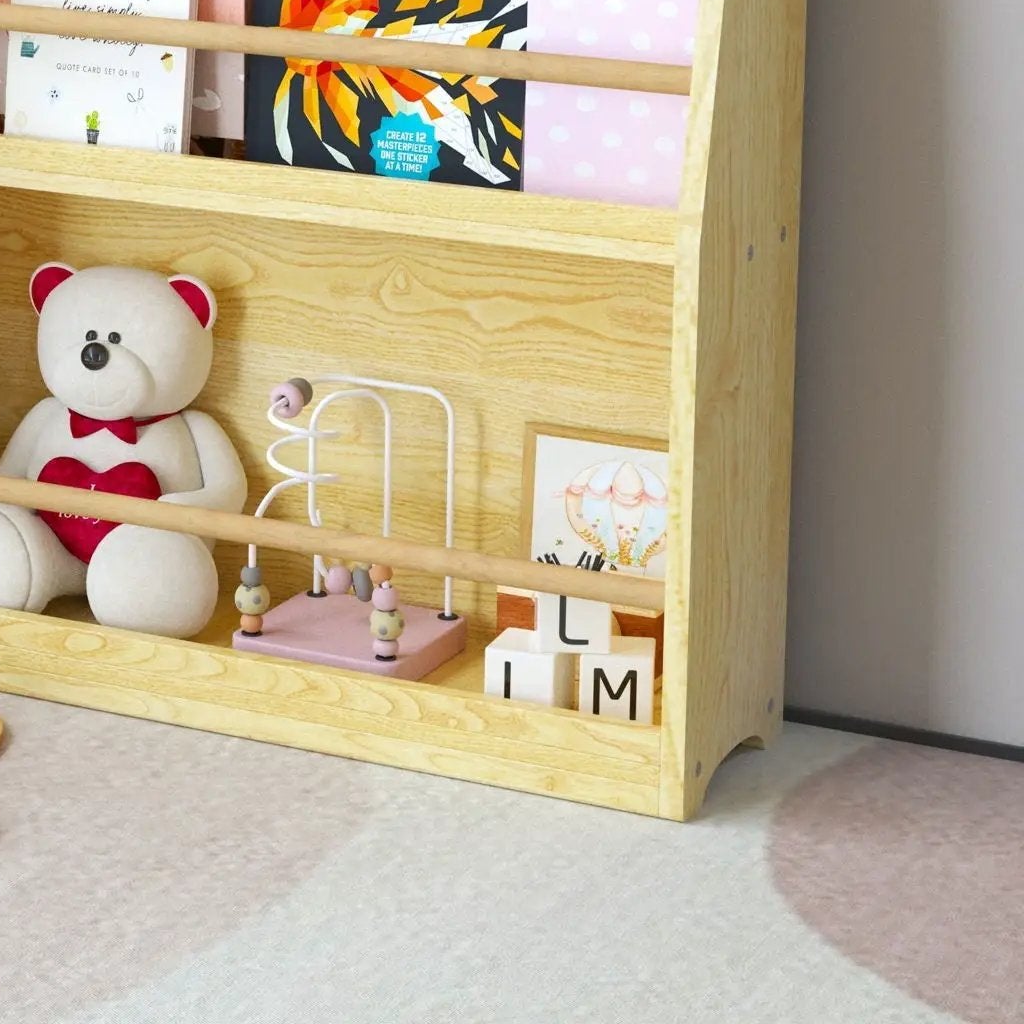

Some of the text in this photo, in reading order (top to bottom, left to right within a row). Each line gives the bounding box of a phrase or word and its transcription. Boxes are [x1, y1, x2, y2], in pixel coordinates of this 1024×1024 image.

[56, 62, 80, 71] QUOTE
[83, 65, 101, 74] CARD
[104, 67, 116, 76] SET
[118, 68, 128, 77] OF
[386, 130, 427, 142] CREATE 12
[377, 140, 432, 154] MASTERPIECES
[381, 150, 429, 164] ONE STICKER
[385, 161, 423, 173] AT A TIME!
[559, 595, 589, 645] L
[593, 667, 638, 720] M
